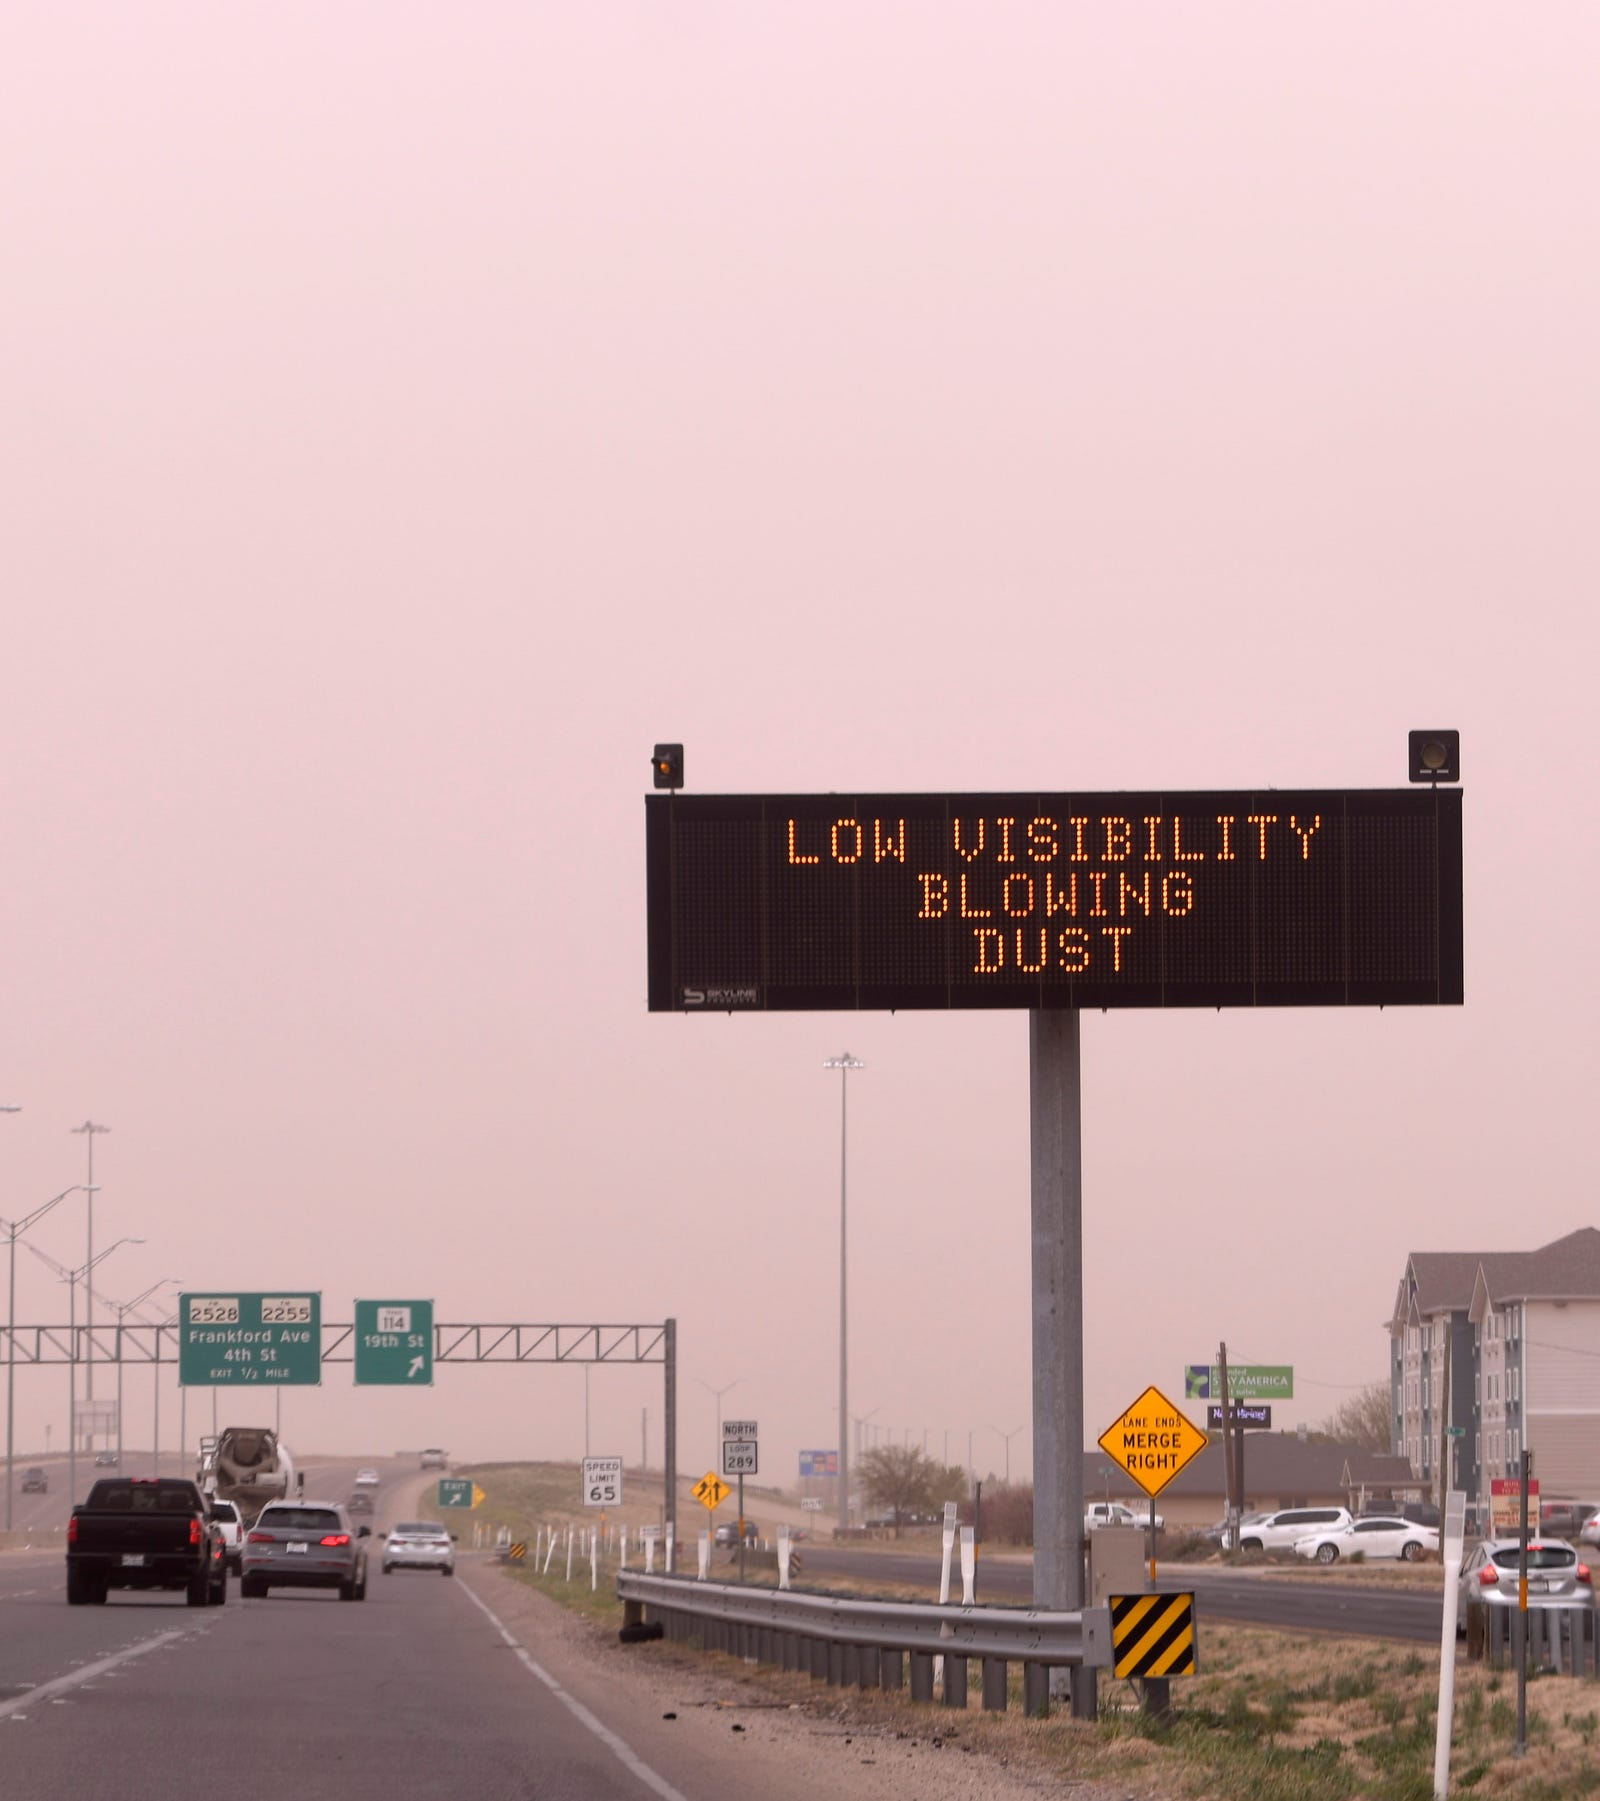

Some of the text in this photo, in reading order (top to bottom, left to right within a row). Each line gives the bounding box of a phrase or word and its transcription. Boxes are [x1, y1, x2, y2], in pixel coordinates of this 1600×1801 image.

[788, 814, 1322, 865] LOW VISIBILITY
[917, 871, 1194, 919] BLOWING
[973, 927, 1133, 973] DUST
[707, 989, 757, 998] SKYLINE
[191, 1307, 238, 1321] 2528
[263, 1307, 310, 1321] 2255
[383, 1317, 404, 1330] 114
[189, 1329, 311, 1344] Frankford Ave
[363, 1334, 425, 1348] 19th St
[224, 1348, 277, 1362] 4th St
[209, 1368, 233, 1379] EXIT
[265, 1368, 291, 1379] MILE
[1238, 1376, 1289, 1387] AMERICA
[1122, 1416, 1182, 1429] LANE ENDS
[724, 1424, 756, 1436] NORTH
[1123, 1433, 1182, 1449] MERGE
[586, 1462, 620, 1472] SPEED
[727, 1456, 754, 1469] 289
[1127, 1453, 1179, 1470] RIGHT
[589, 1474, 617, 1484] LIMIT
[443, 1482, 467, 1491] EXIT
[590, 1486, 616, 1502] 65
